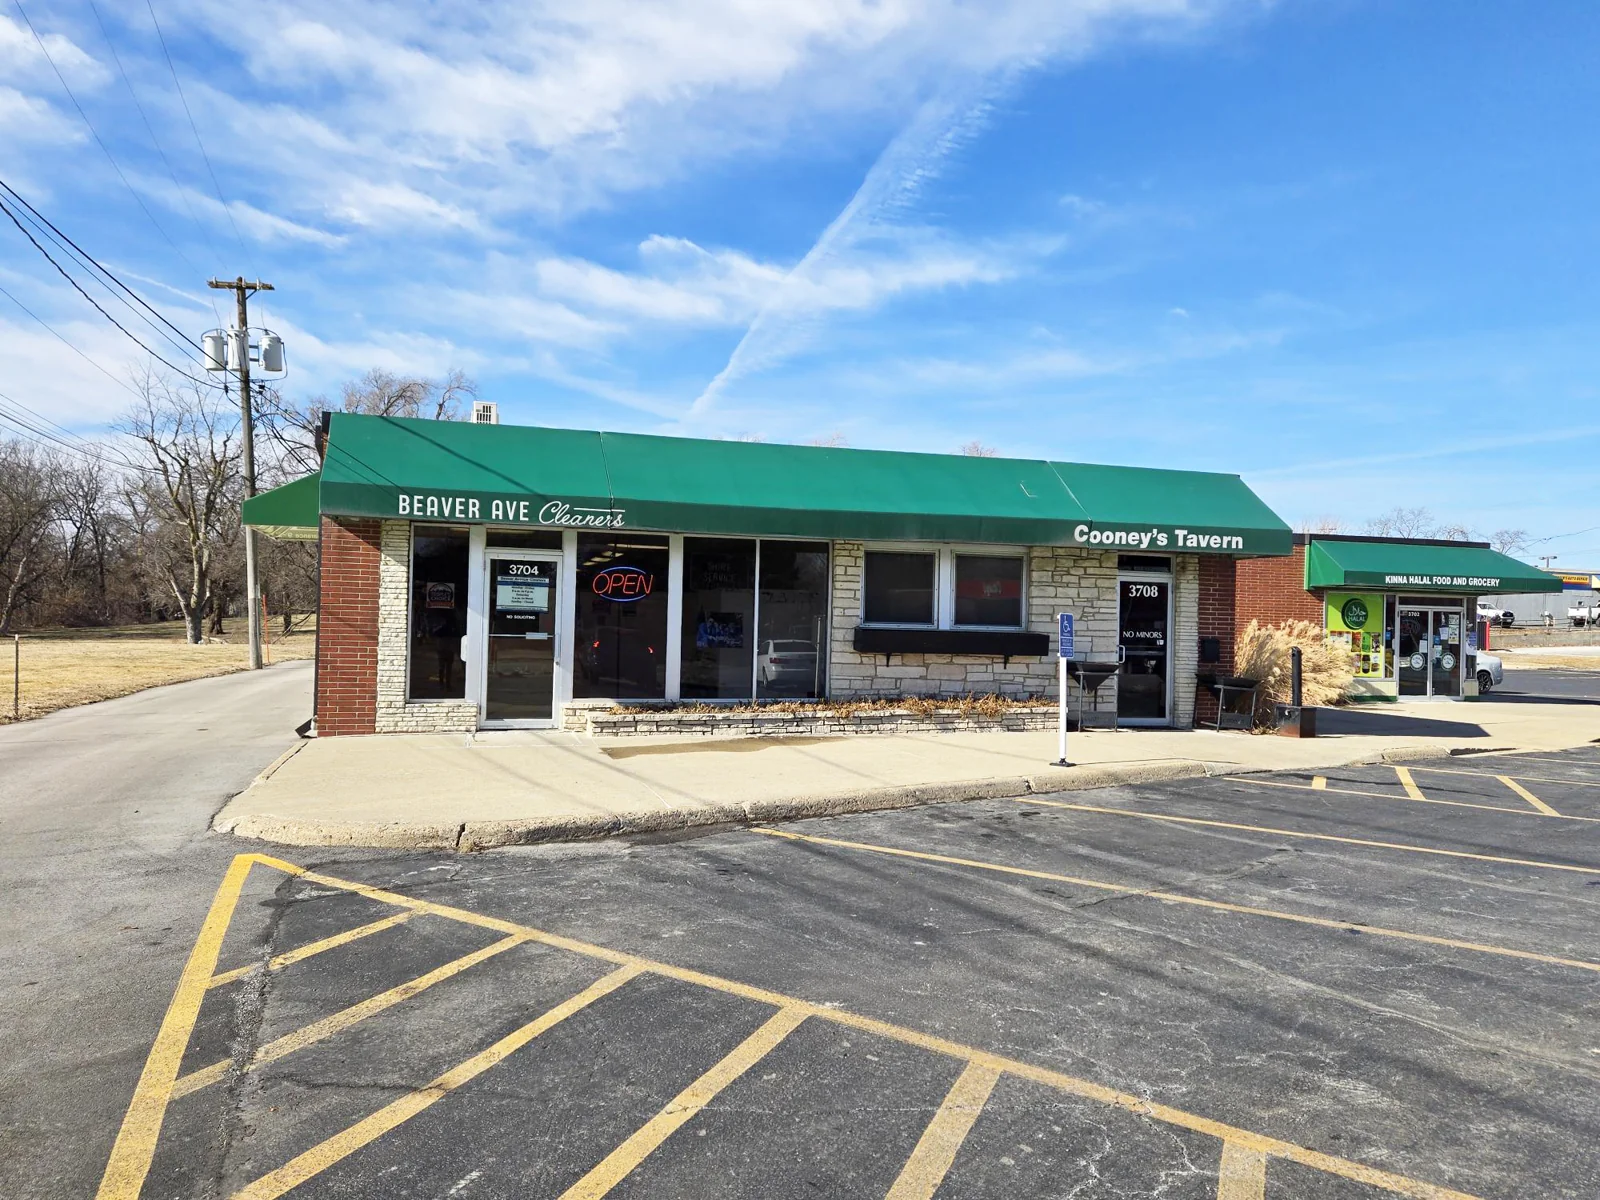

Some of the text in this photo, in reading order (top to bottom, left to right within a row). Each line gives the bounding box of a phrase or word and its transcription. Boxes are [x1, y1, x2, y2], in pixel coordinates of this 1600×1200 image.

[398, 494, 625, 527] BEAVER AVE Cleaners
[1073, 524, 1243, 549] Cooney's Tavern
[509, 564, 539, 575] 3704
[592, 573, 654, 594] OPEN
[1385, 575, 1500, 587] KINNA HALAL FOOD AND GROCERY
[1128, 584, 1159, 598] 3708
[1122, 630, 1163, 639] NO MINORS
